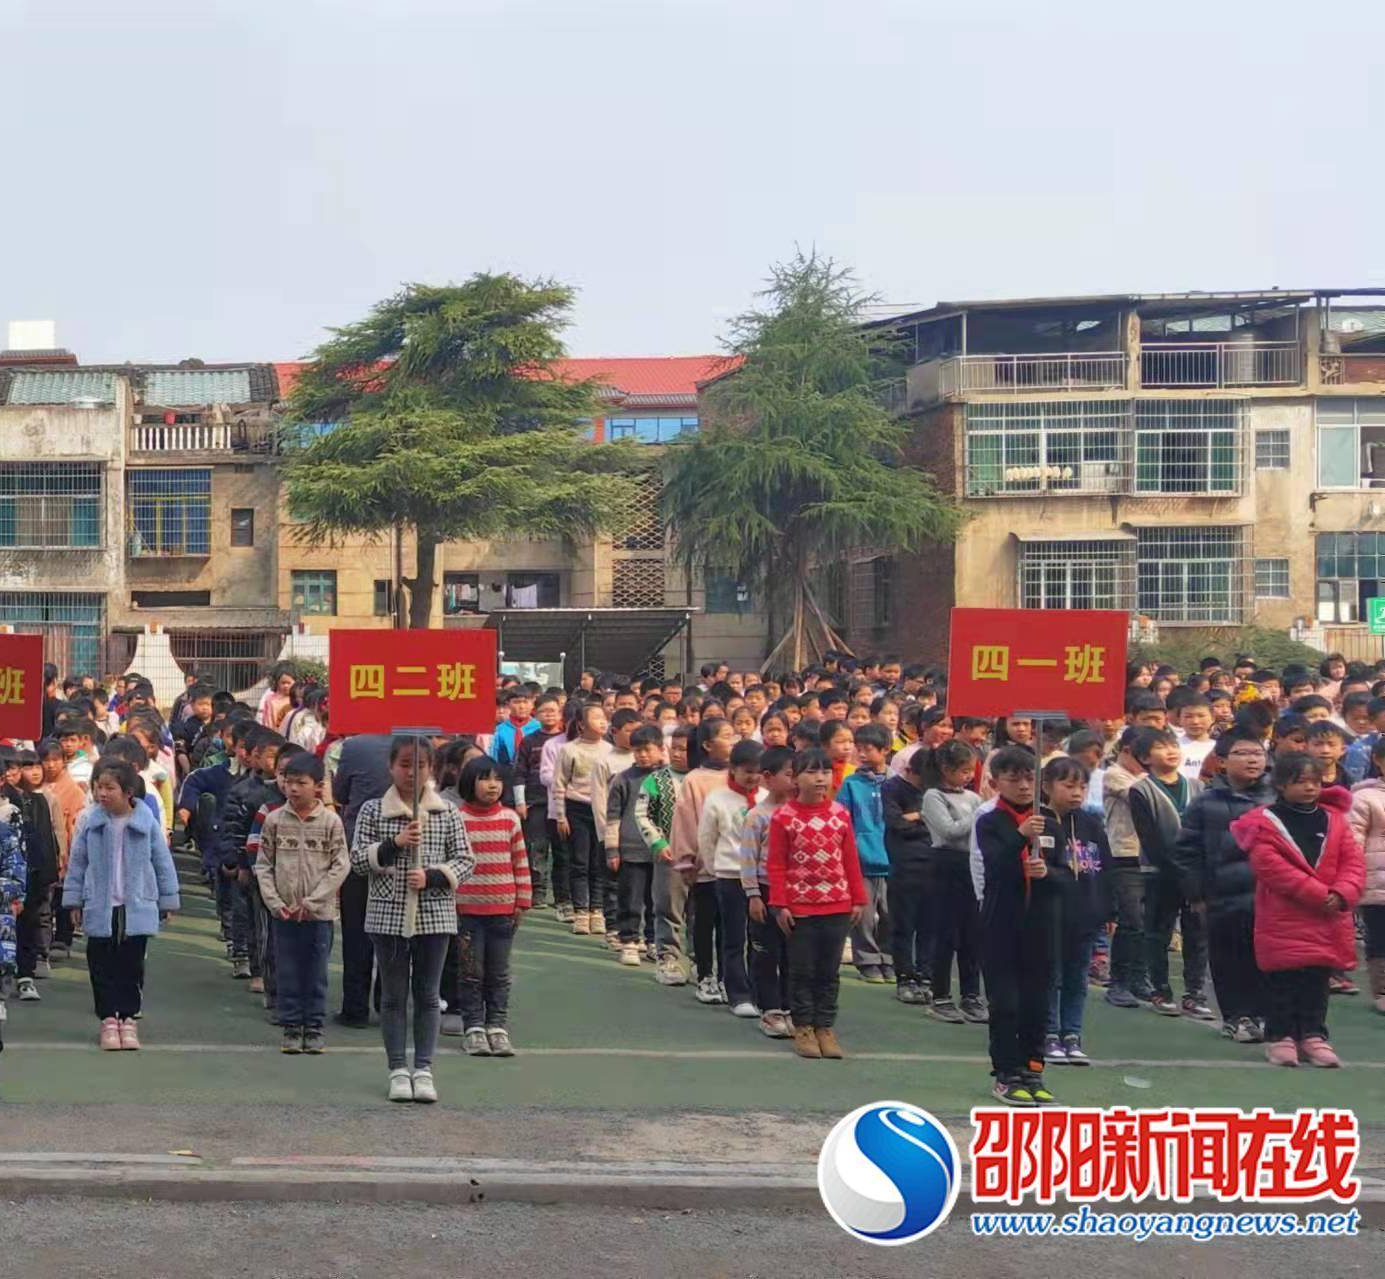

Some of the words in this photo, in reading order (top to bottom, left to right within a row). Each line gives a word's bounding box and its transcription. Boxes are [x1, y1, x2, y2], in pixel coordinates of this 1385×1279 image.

[350, 662, 477, 700] 四二班
[971, 643, 1106, 684] 四一班
